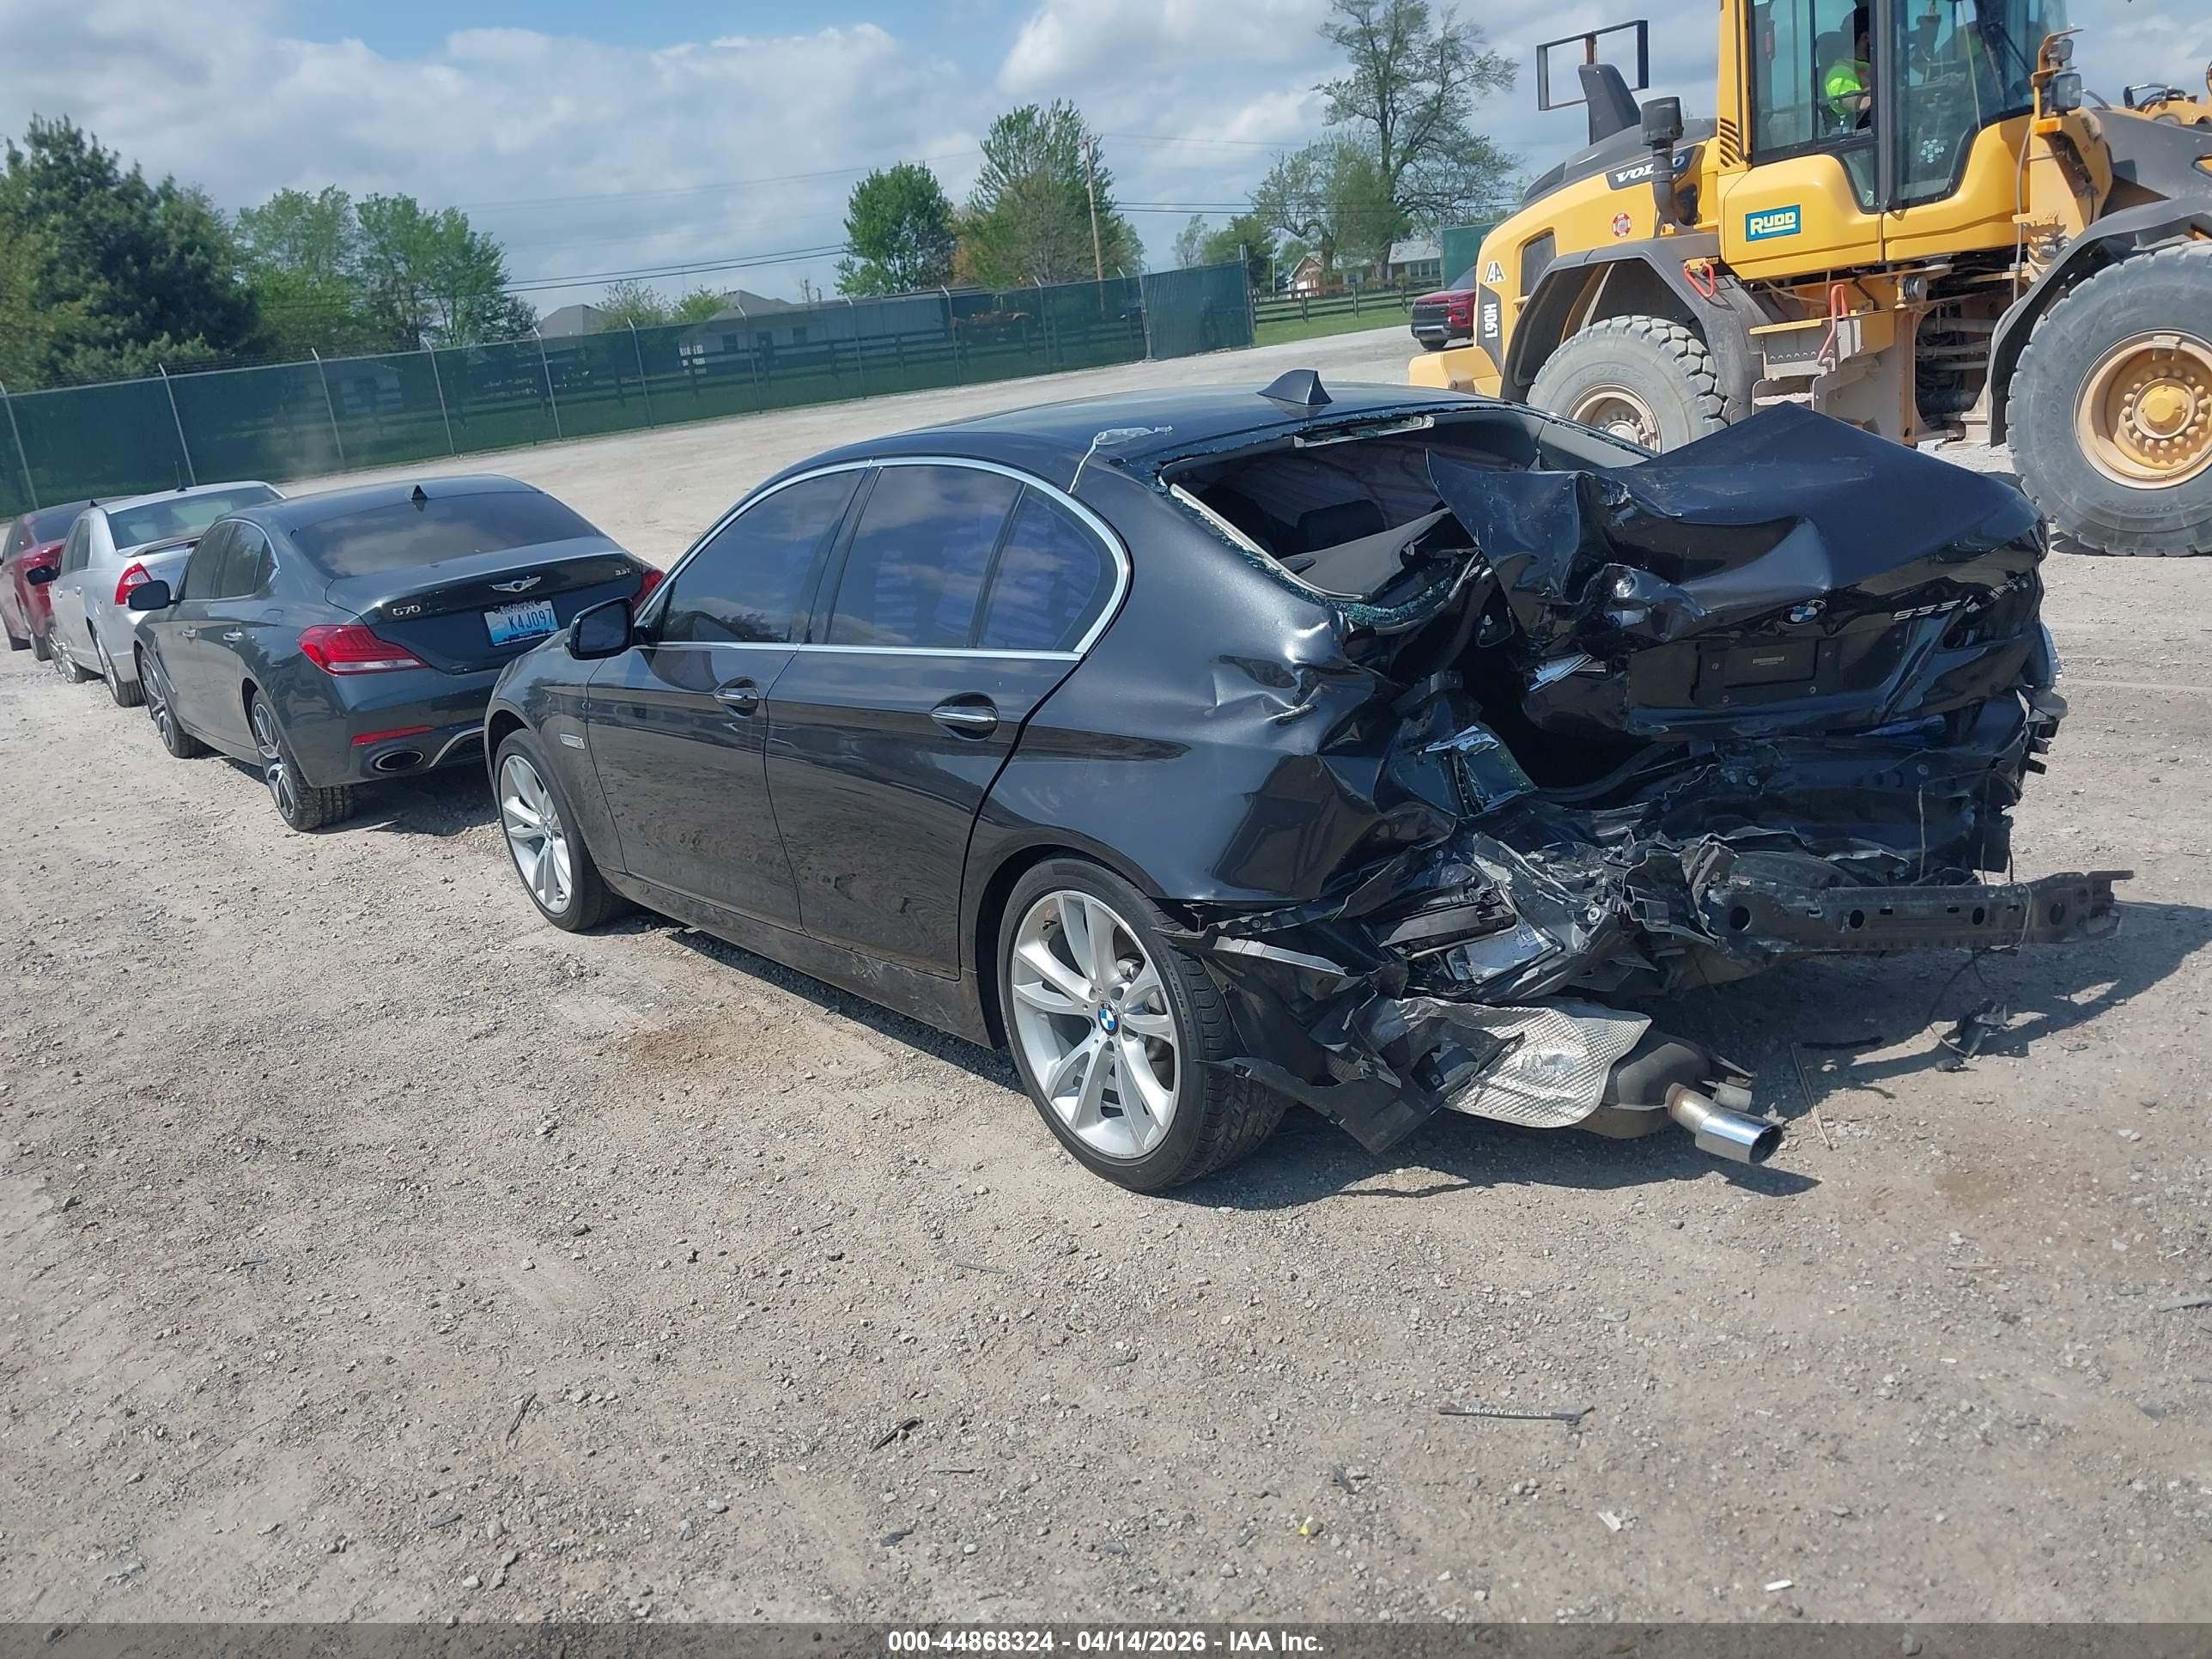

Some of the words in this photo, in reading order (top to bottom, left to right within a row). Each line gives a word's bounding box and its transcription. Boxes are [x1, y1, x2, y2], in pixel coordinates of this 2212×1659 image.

[1615, 156, 1686, 183] VOLO
[1750, 211, 1796, 235] RUDD
[1484, 303, 1498, 338] L90H
[392, 605, 421, 617] G70
[507, 608, 553, 632] K4J097
